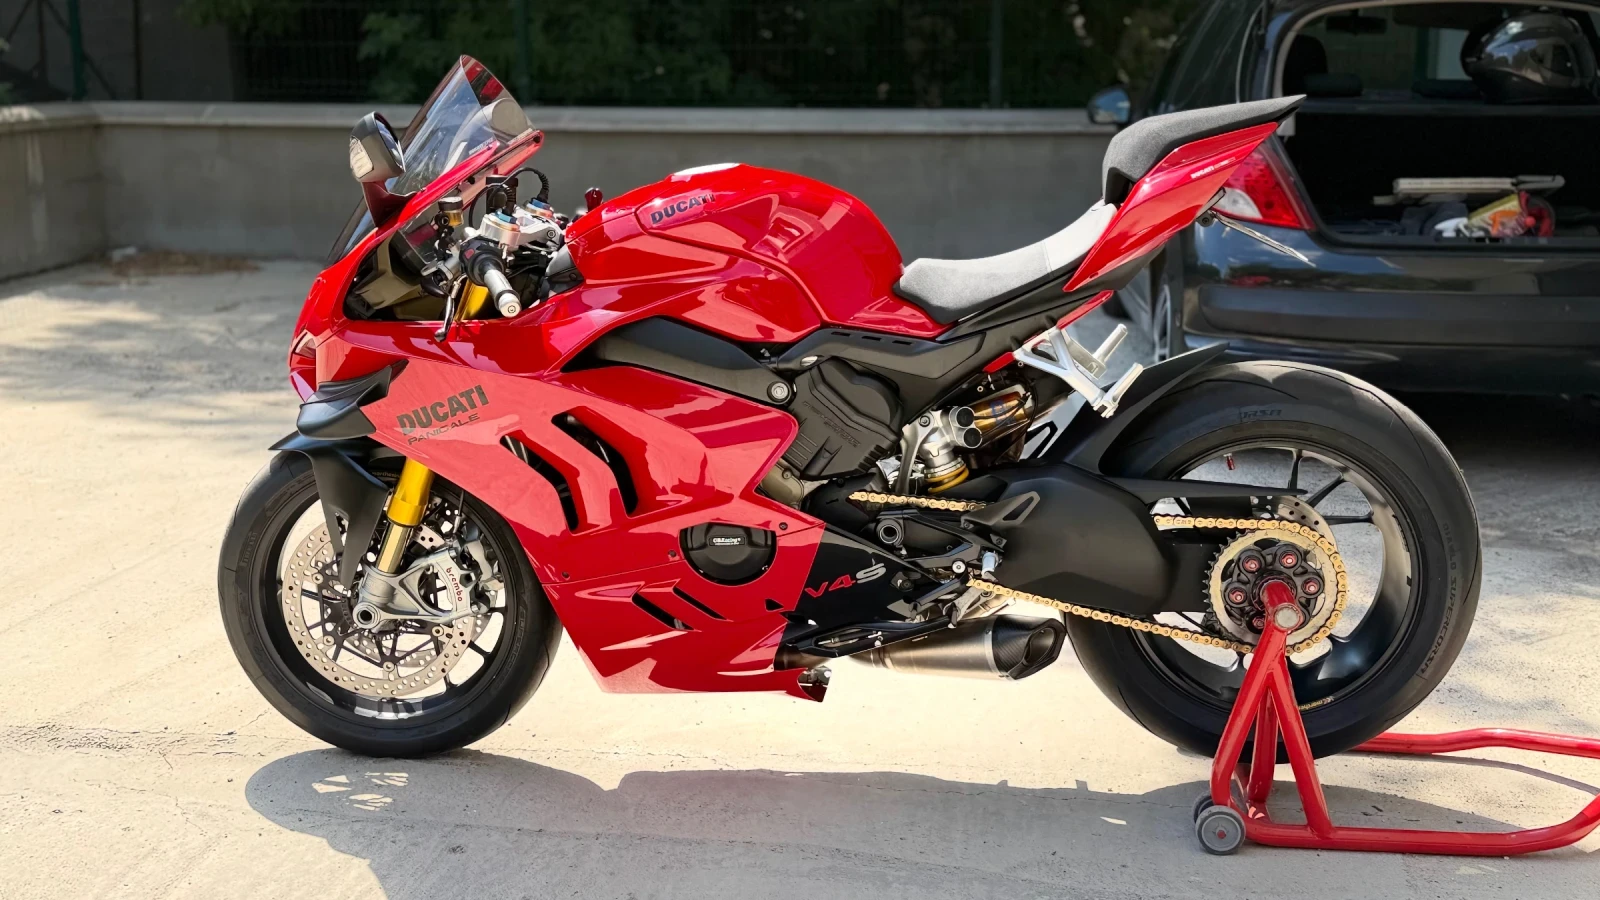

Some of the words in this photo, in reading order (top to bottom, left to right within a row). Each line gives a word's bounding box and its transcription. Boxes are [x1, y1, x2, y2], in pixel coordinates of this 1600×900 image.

[650, 194, 716, 224] DUCATI
[396, 384, 490, 436] DUCATI
[445, 566, 464, 602] brembo
[804, 562, 887, 598] V4S
